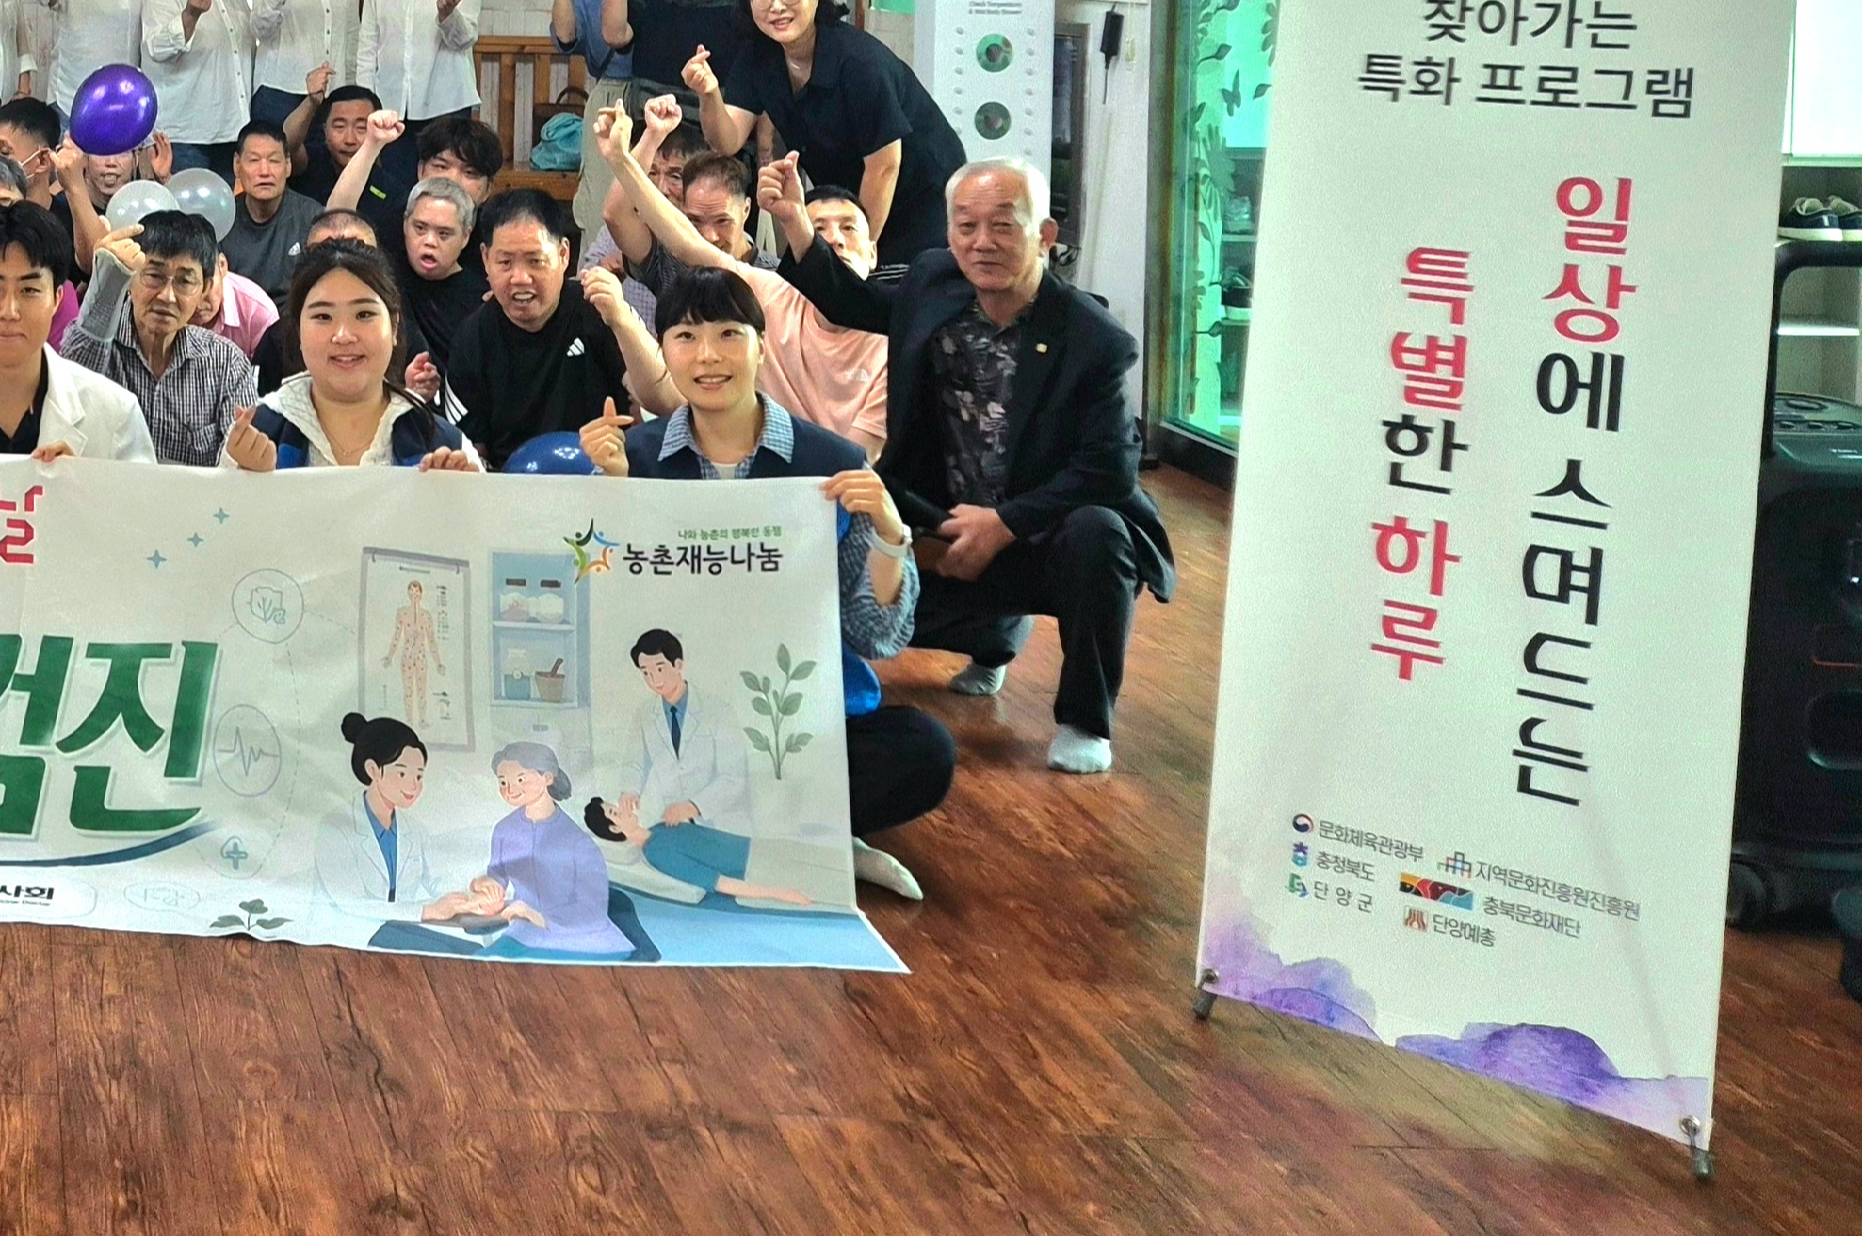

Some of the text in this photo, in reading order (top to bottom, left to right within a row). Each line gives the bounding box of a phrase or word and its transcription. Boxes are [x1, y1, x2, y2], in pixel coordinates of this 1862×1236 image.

[1358, 54, 1695, 118] 특화 프로그램
[1370, 248, 1476, 680] 특별한 하루
[1513, 176, 1636, 807] 일상에 스며드는
[623, 542, 783, 575] 농촌재능나눔
[1319, 820, 1423, 862] 문화체육관광부
[1316, 852, 1375, 882] 충청북도
[1476, 861, 1640, 922] 지역문화진흥원진흥원
[1433, 914, 1496, 947] 단양예총
[1482, 897, 1580, 938] 충북문화재단
